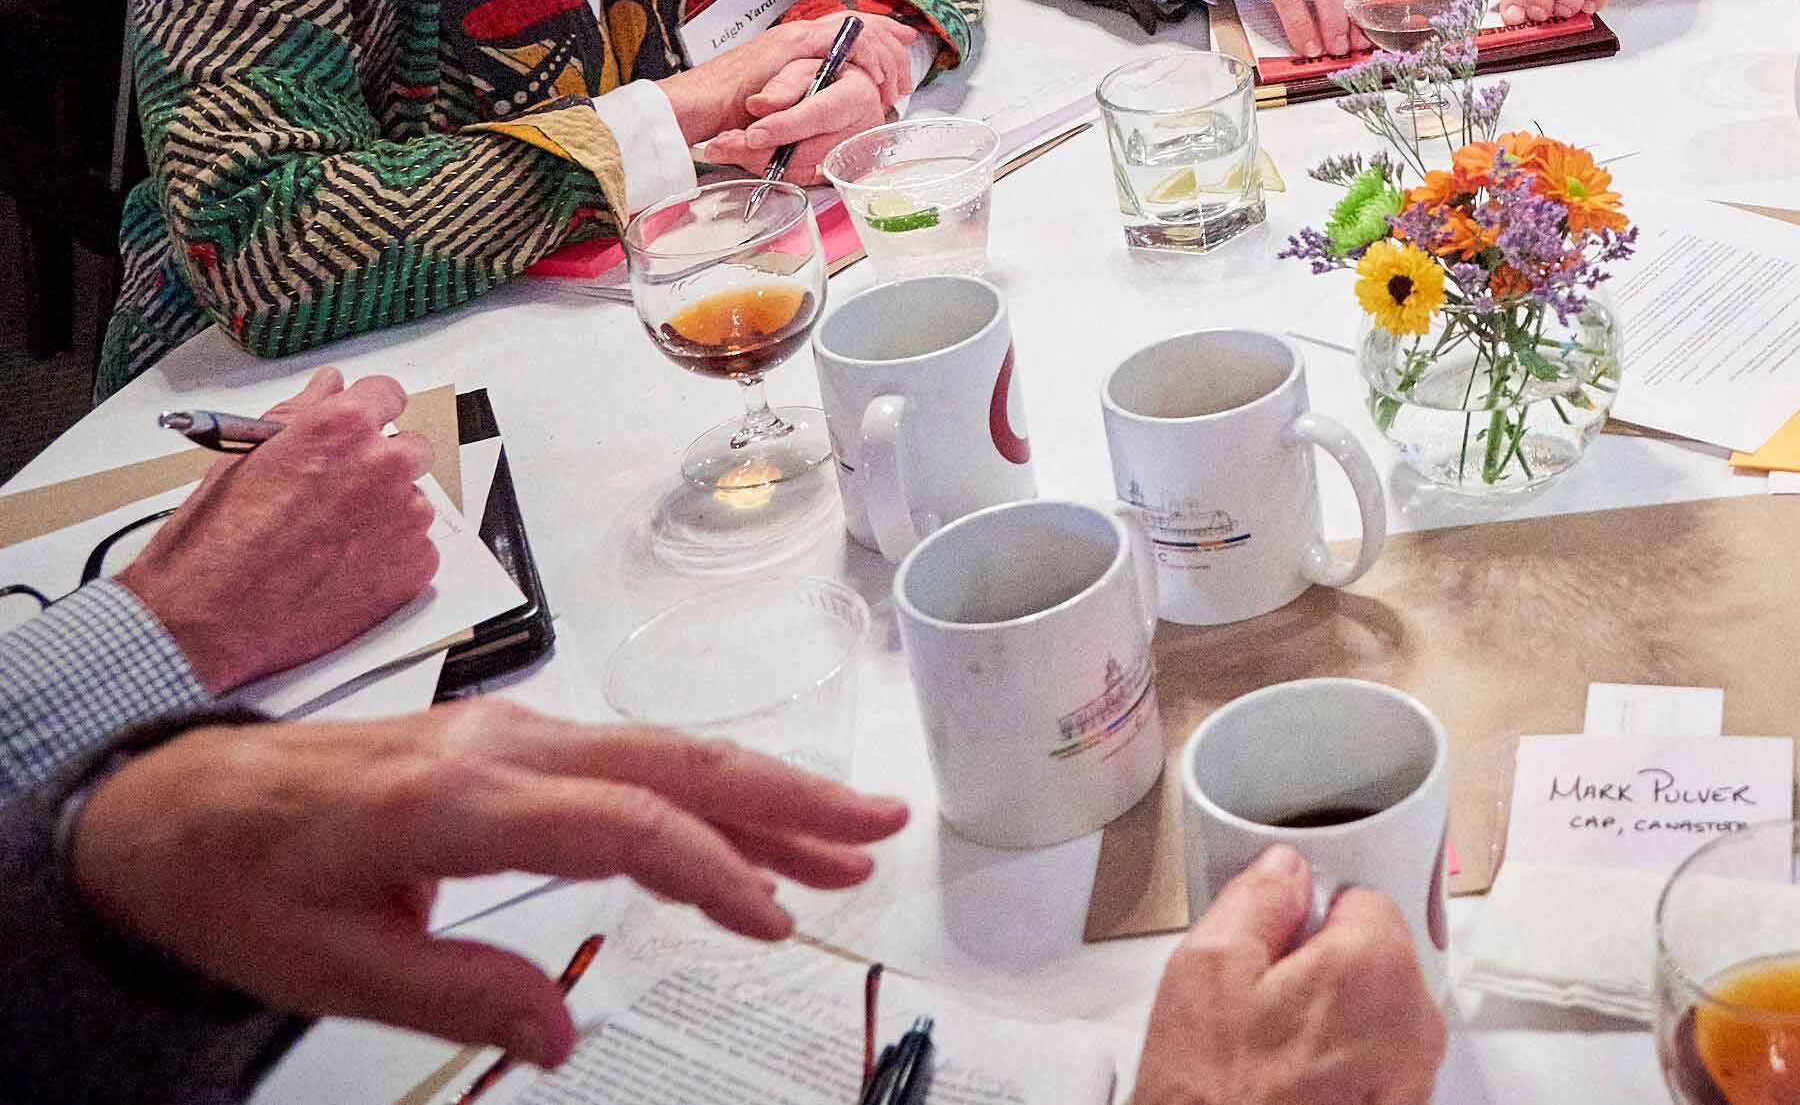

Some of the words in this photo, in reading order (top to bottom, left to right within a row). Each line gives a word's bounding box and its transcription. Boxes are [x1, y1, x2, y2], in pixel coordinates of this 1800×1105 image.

[711, 21, 744, 49] Leigh
[1549, 775, 1633, 802] MARK
[1637, 768, 1757, 805] PULVER
